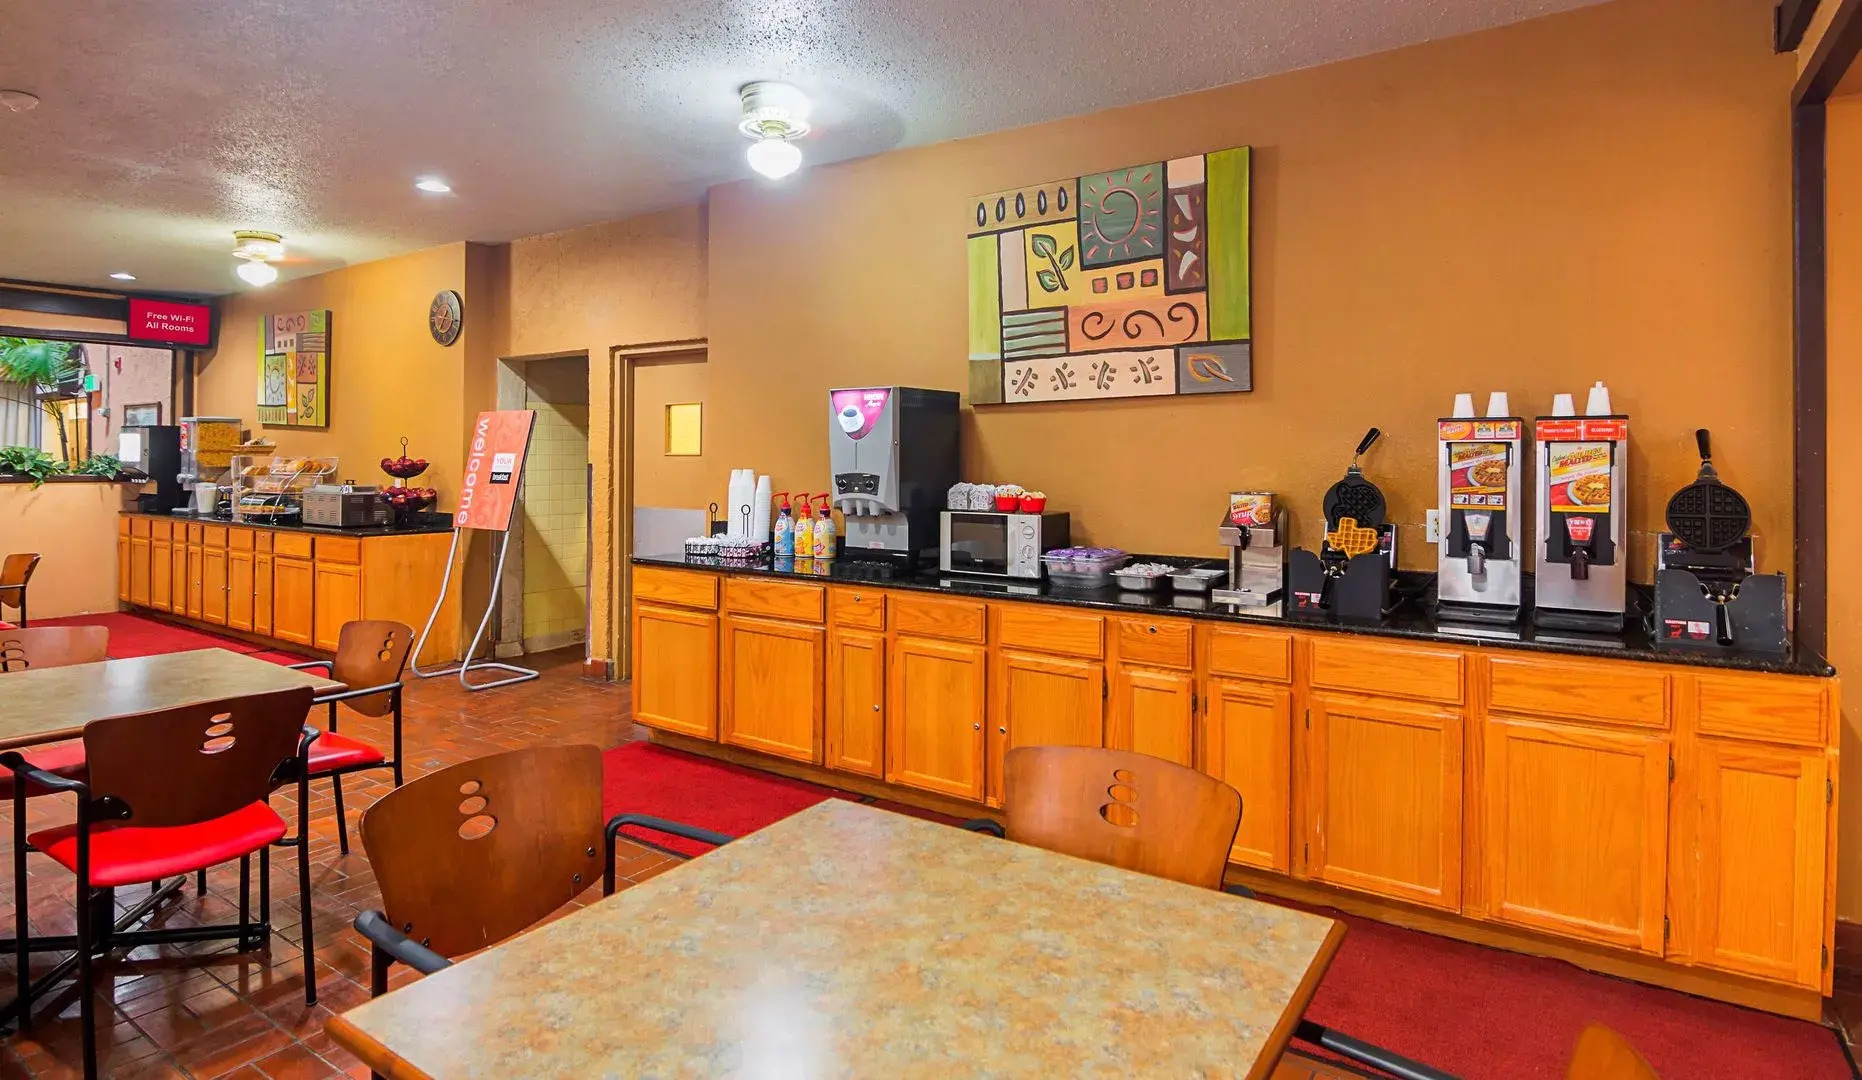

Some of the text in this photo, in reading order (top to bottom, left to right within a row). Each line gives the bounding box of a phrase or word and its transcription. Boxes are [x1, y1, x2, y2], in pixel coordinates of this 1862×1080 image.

[146, 311, 168, 320] Free
[146, 321, 194, 333] All Rooms
[457, 418, 490, 524] welcome
